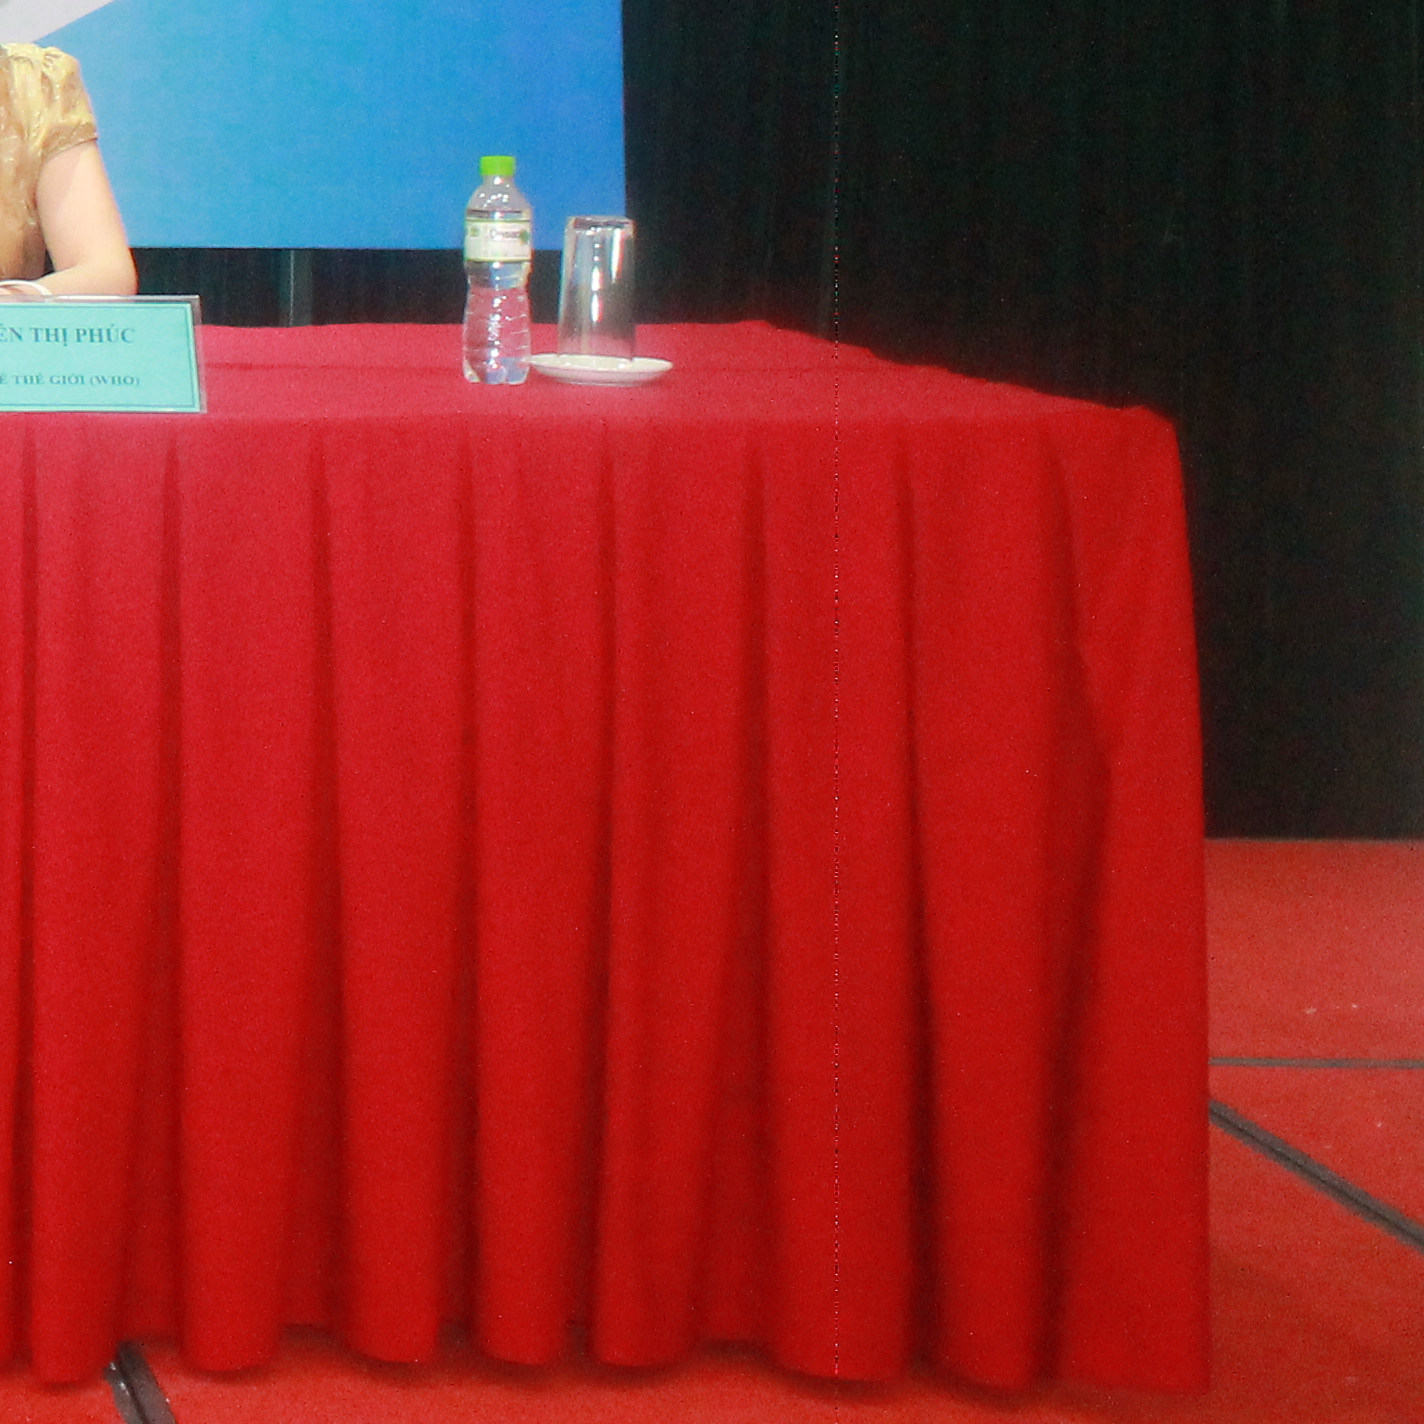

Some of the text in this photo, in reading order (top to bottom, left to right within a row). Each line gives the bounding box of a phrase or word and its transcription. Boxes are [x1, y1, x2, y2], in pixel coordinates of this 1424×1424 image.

[28, 326, 70, 347] THỊ
[75, 323, 136, 344] PHÚC
[89, 374, 141, 388] (WHO)
